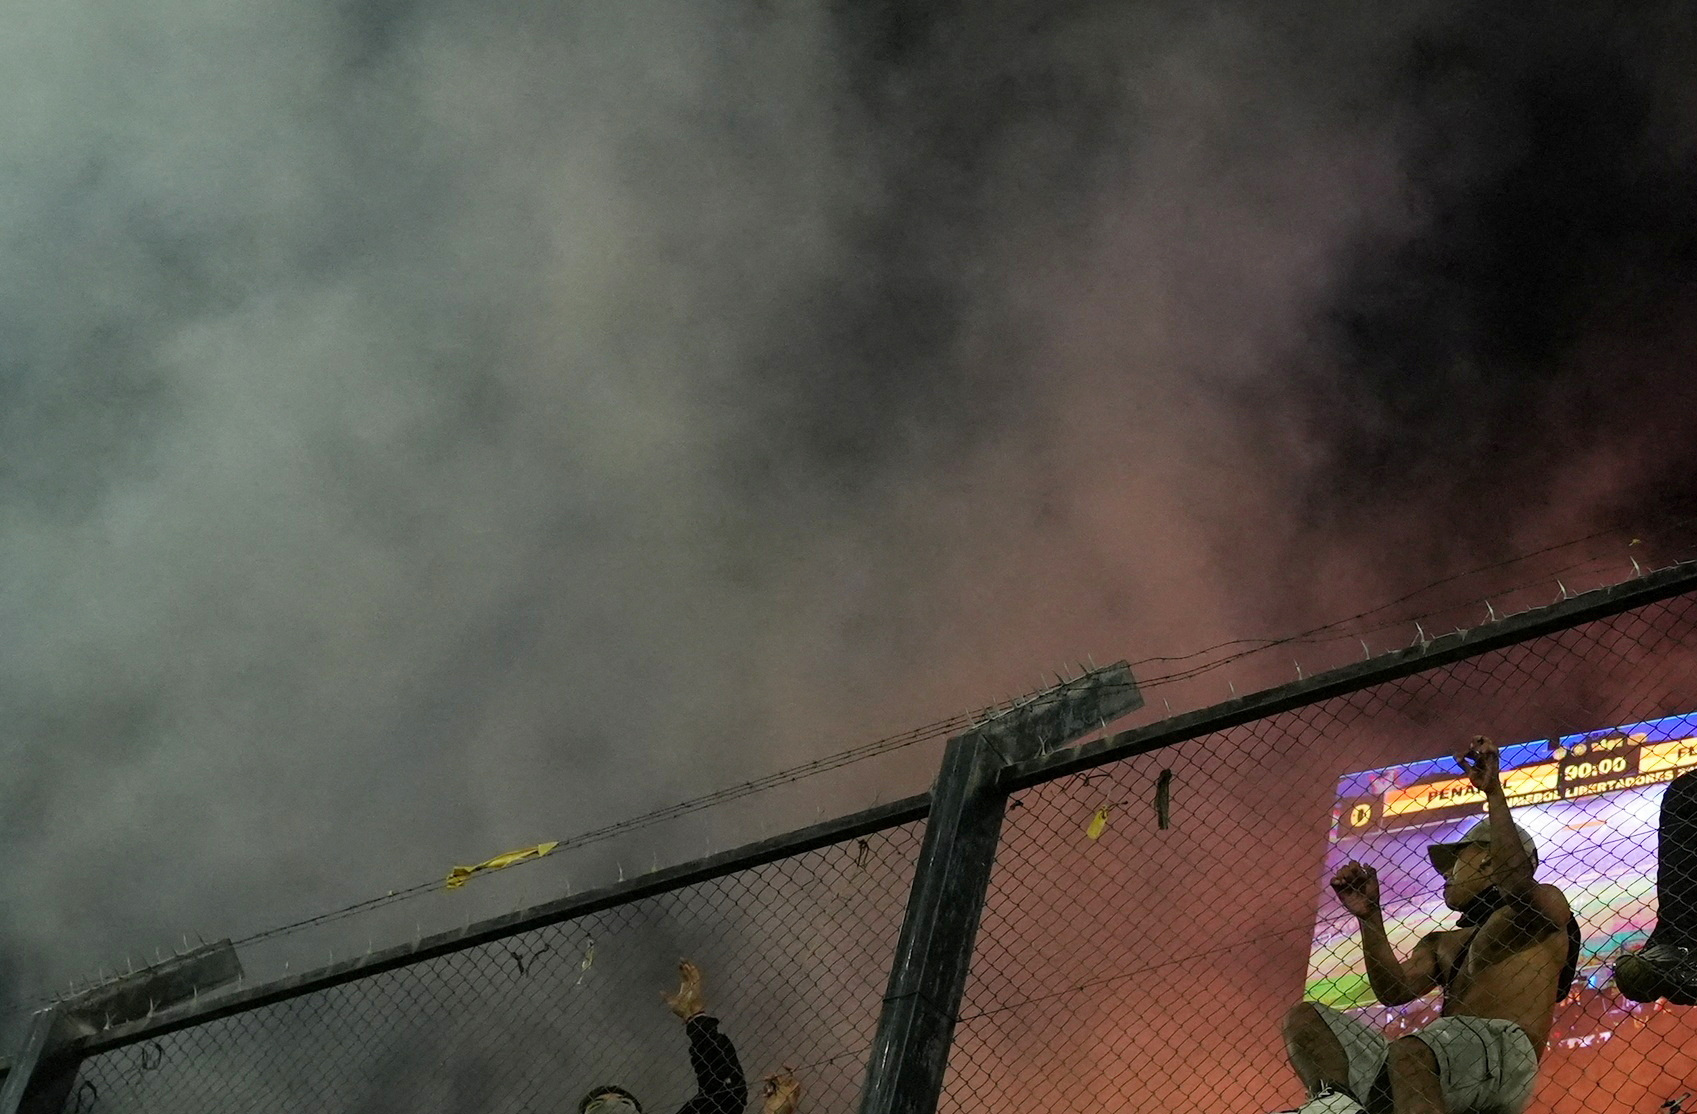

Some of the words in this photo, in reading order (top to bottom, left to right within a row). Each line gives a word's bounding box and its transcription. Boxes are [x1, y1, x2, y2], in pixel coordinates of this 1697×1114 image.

[1564, 756, 1626, 781] 90:00
[1483, 789, 1561, 812] CNMEBOL
[1565, 769, 1674, 798] LIBERTADORES
